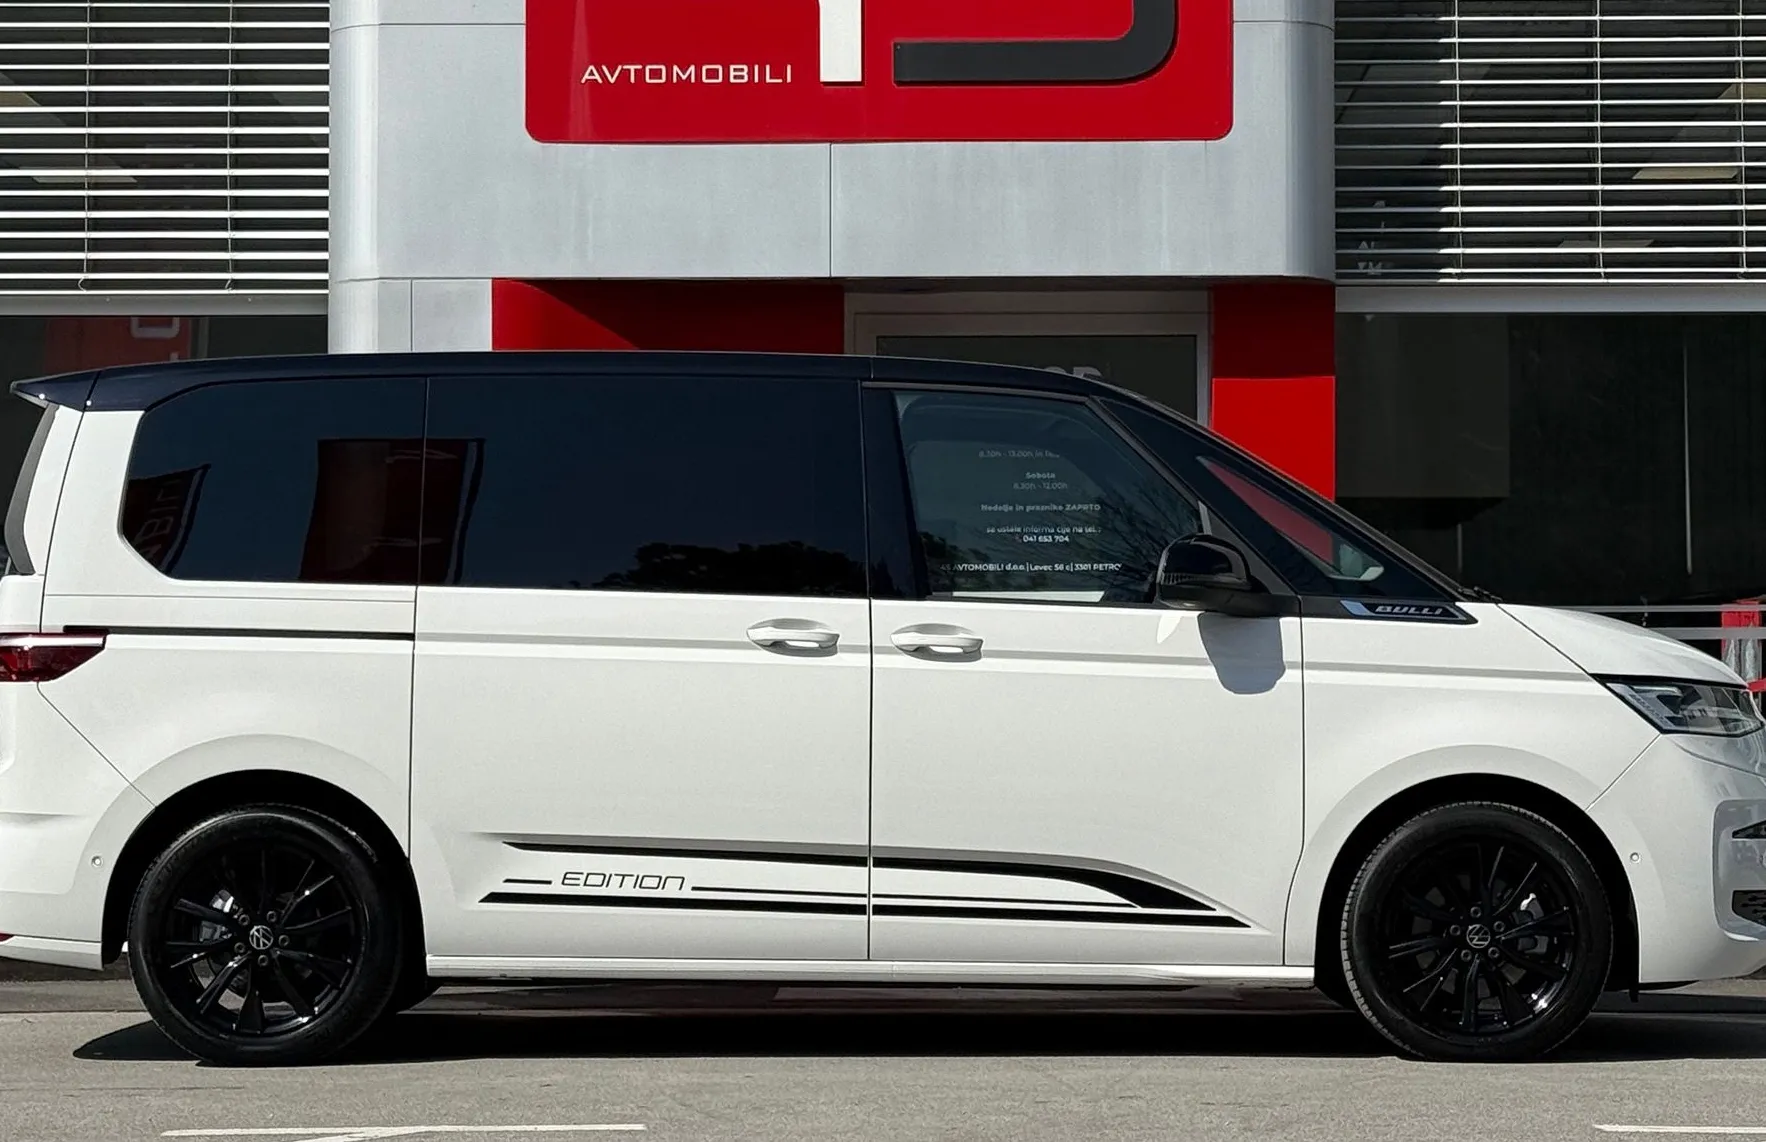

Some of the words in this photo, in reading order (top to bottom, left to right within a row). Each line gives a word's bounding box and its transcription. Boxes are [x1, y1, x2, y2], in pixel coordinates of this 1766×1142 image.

[580, 64, 792, 84] AVTOMOBILI
[1375, 605, 1442, 615] BULLI
[561, 871, 685, 891] EDITION
